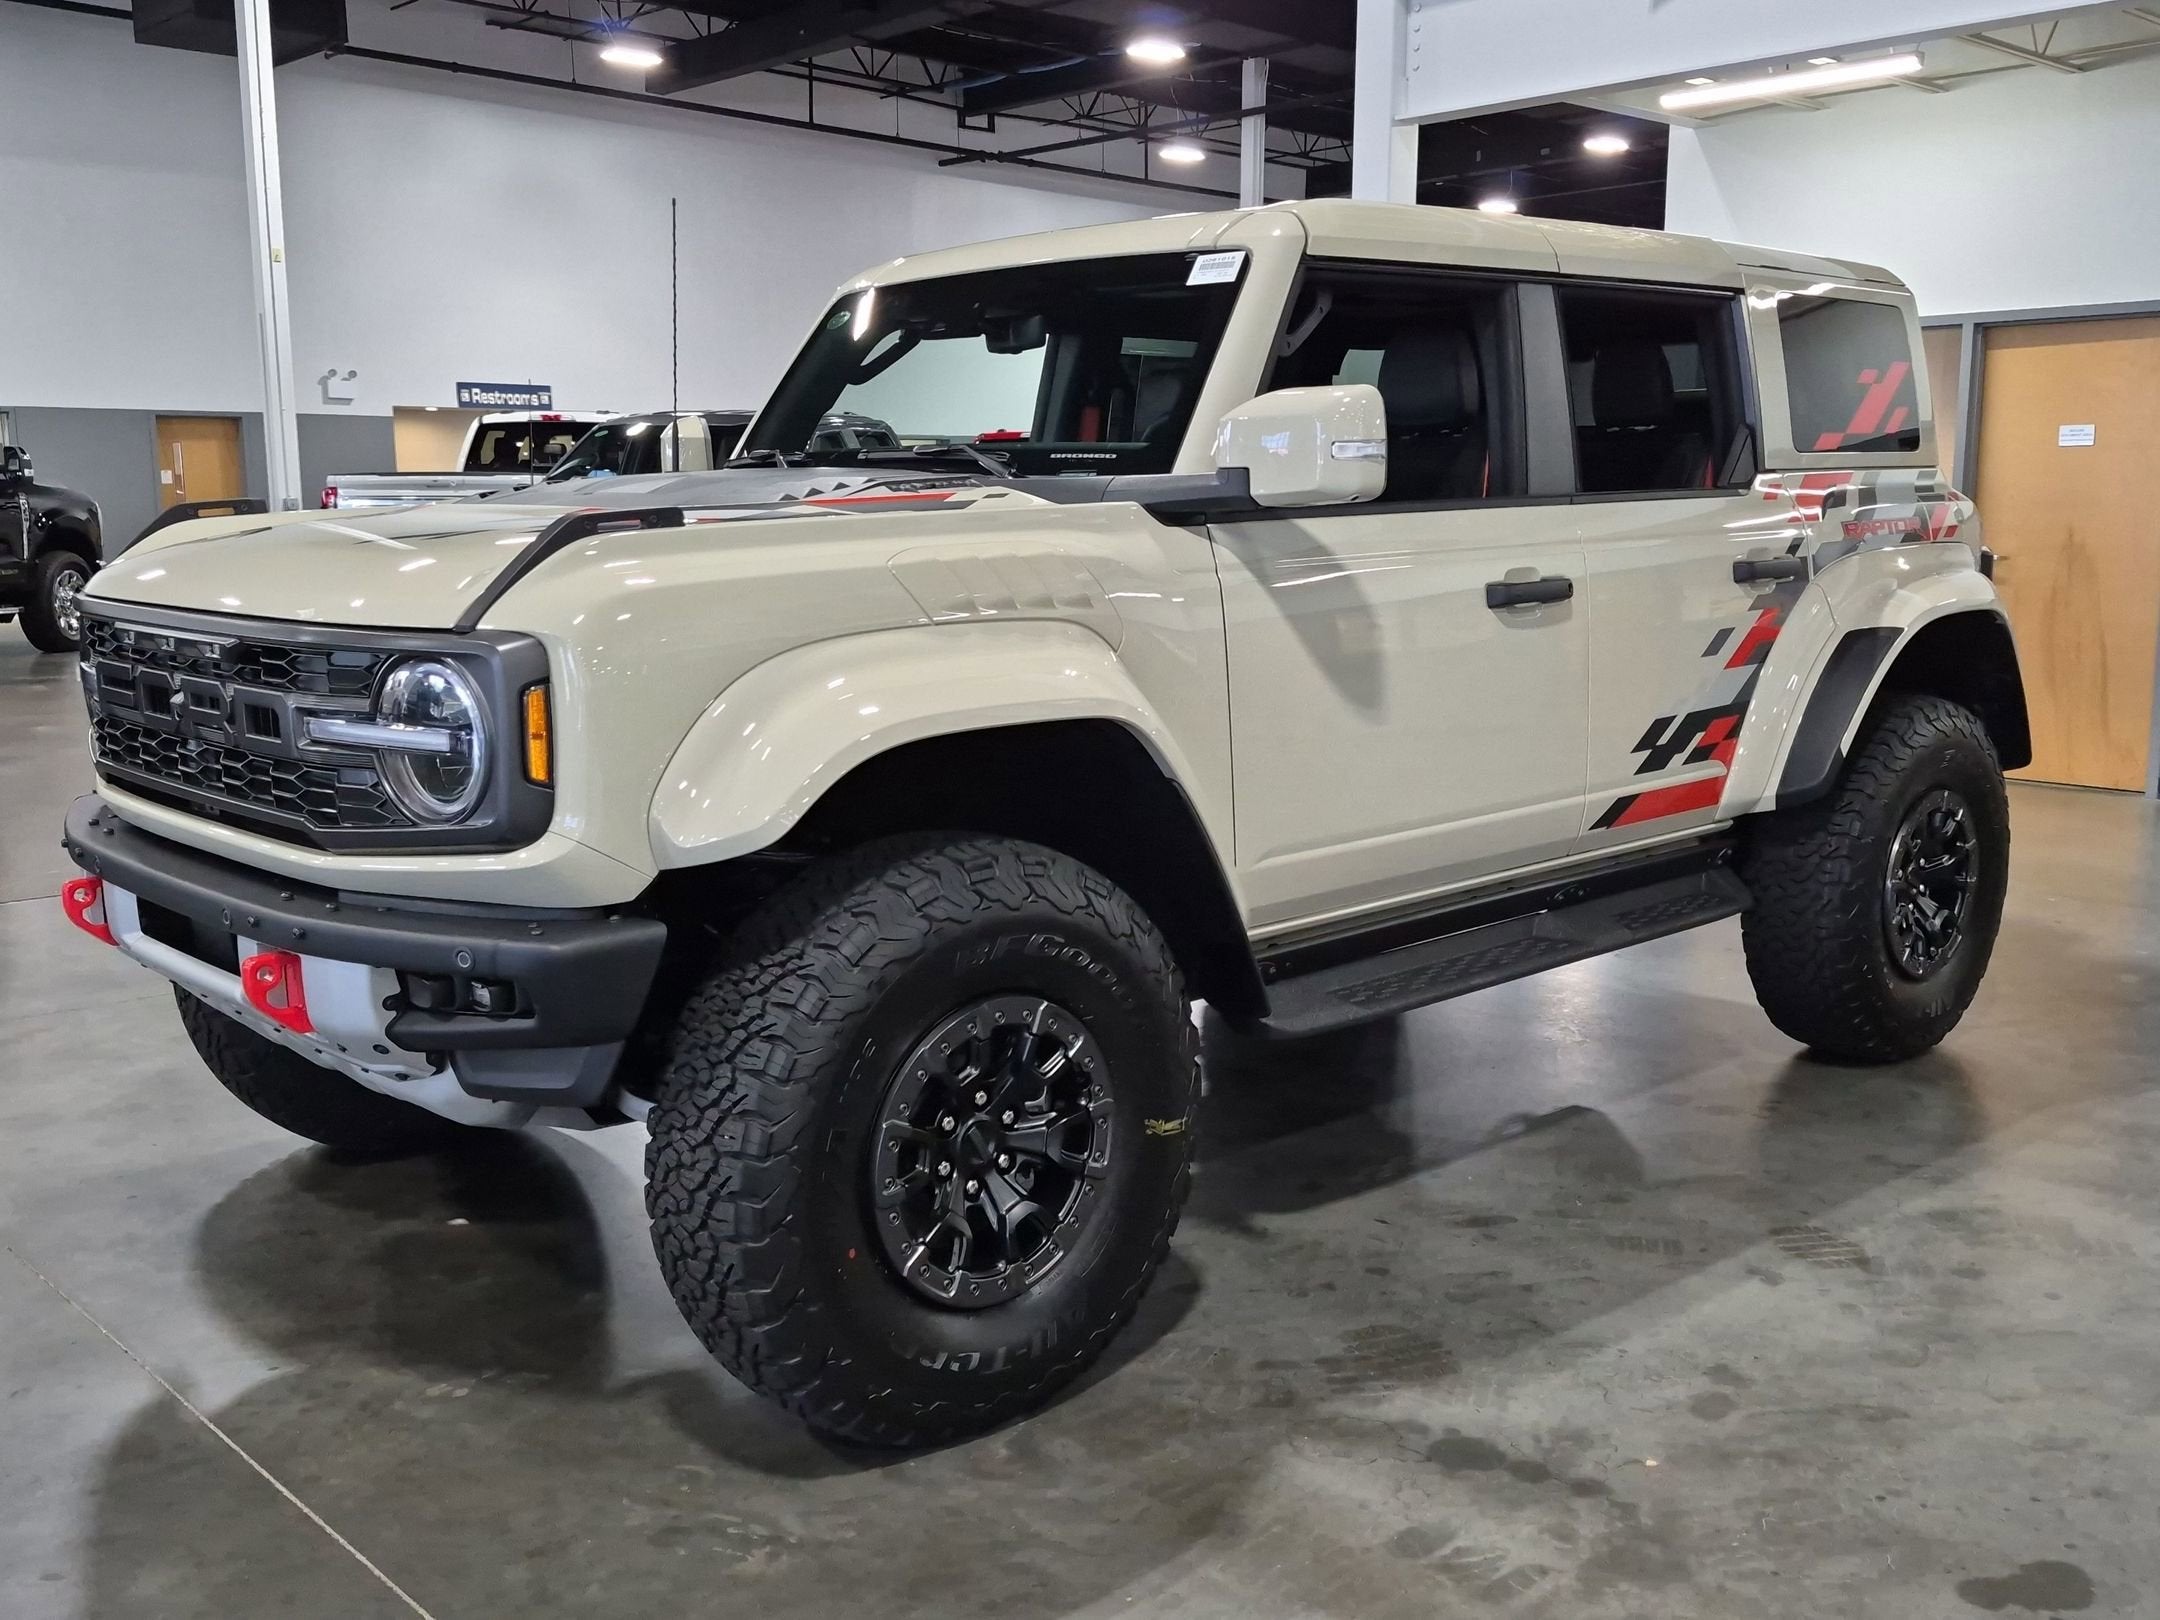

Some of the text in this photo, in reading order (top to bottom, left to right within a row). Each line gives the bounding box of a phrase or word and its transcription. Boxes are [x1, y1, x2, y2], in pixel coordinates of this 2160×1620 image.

[471, 388, 539, 406] Restrooms
[1841, 517, 1927, 541] RAPTOR
[95, 657, 292, 757] FORD
